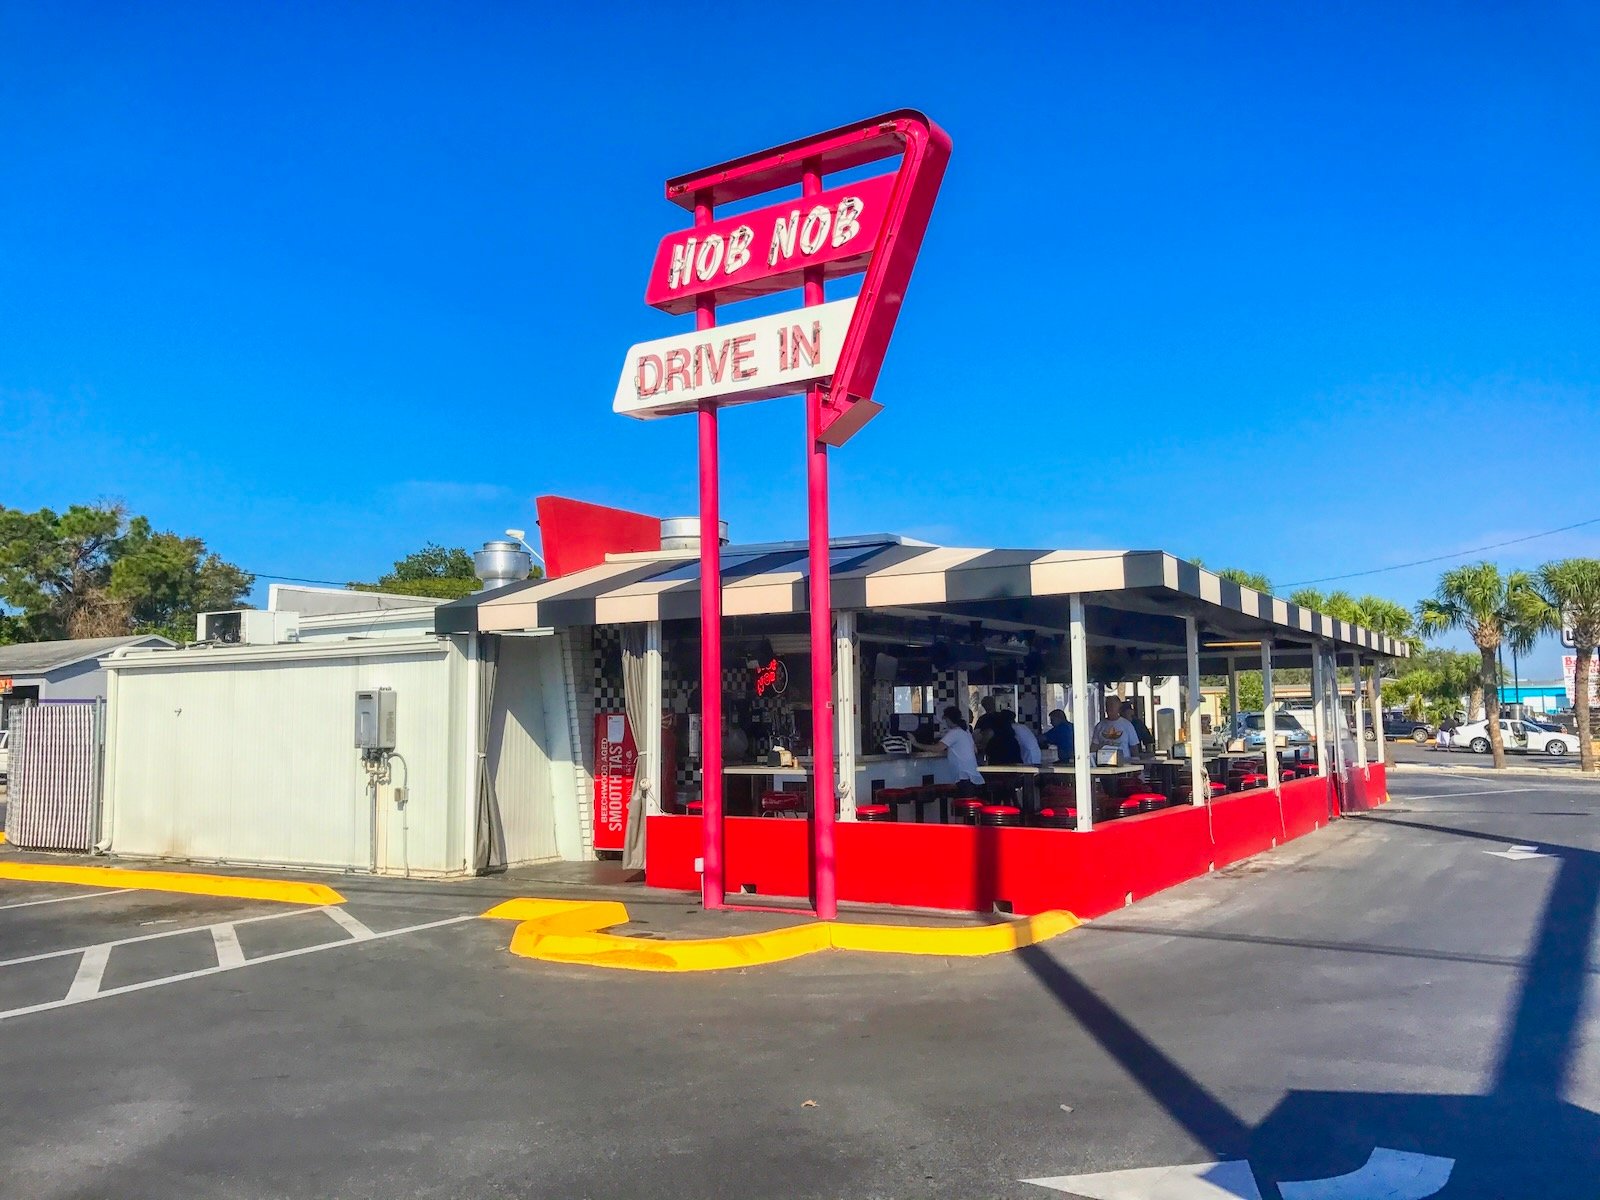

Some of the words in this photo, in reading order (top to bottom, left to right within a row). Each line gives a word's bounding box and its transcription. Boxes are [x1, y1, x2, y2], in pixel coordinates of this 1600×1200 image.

[668, 225, 754, 289] HOB
[768, 196, 864, 267] NOB
[635, 333, 758, 400] DRIVE
[778, 320, 822, 371] IN
[600, 737, 608, 762] AGED
[600, 765, 608, 823] BEECHWOOD
[608, 775, 622, 831] SMOOTH
